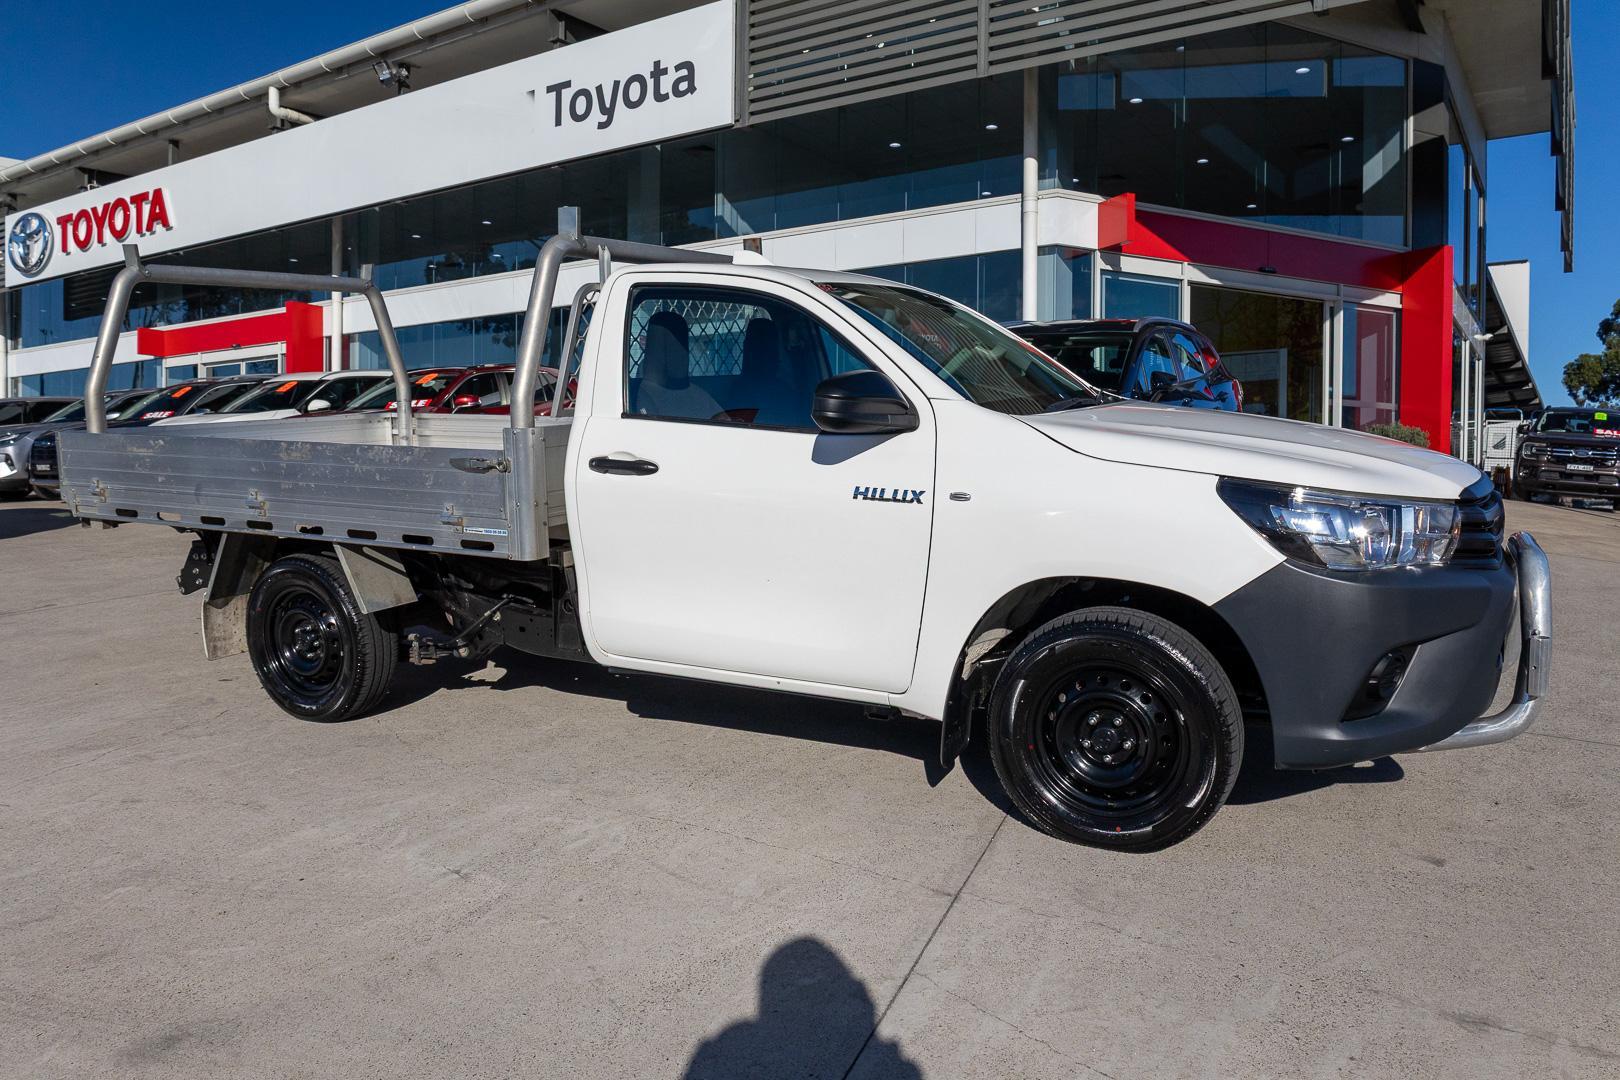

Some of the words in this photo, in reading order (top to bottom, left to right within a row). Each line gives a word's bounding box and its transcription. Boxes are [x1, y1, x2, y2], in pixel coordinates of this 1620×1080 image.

[546, 59, 698, 130] Toyota
[56, 187, 172, 255] TOYOTA
[389, 399, 429, 409] SLE
[142, 410, 172, 420] SALE
[1595, 428, 1620, 436] SAL
[852, 485, 926, 505] HILUX
